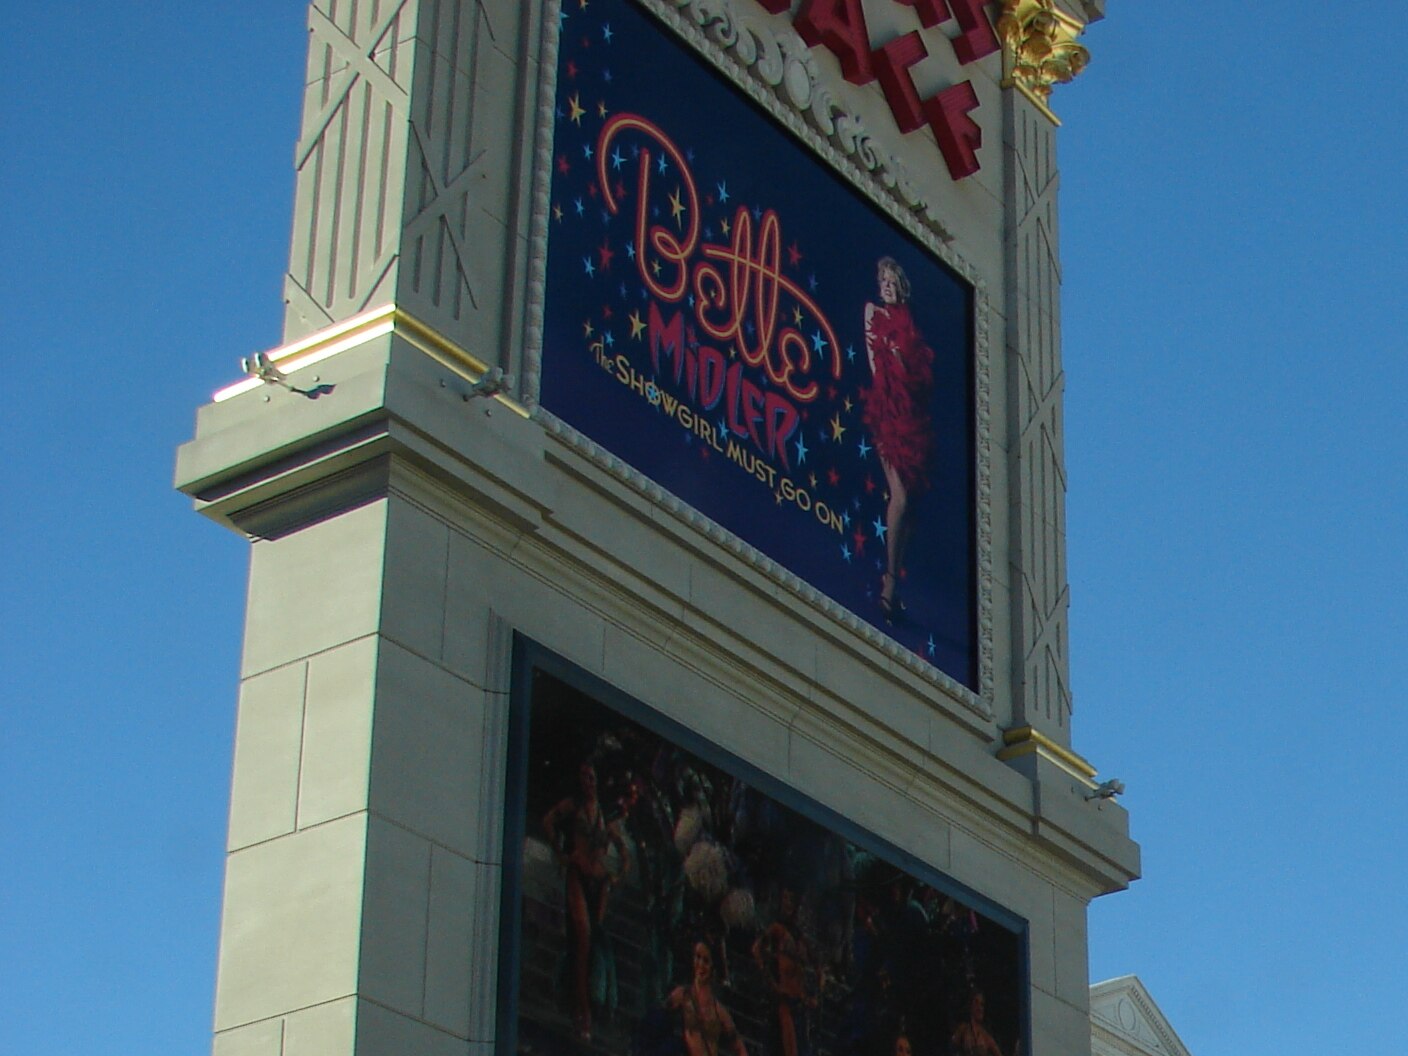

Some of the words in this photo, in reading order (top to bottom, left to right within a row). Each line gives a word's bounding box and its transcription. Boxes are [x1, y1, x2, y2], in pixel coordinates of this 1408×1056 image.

[597, 112, 841, 400] Bette
[590, 336, 615, 374] The
[615, 355, 723, 453] SHOWGIRL
[727, 440, 777, 487] MUST
[781, 478, 811, 511] GO
[815, 502, 844, 534] ON
